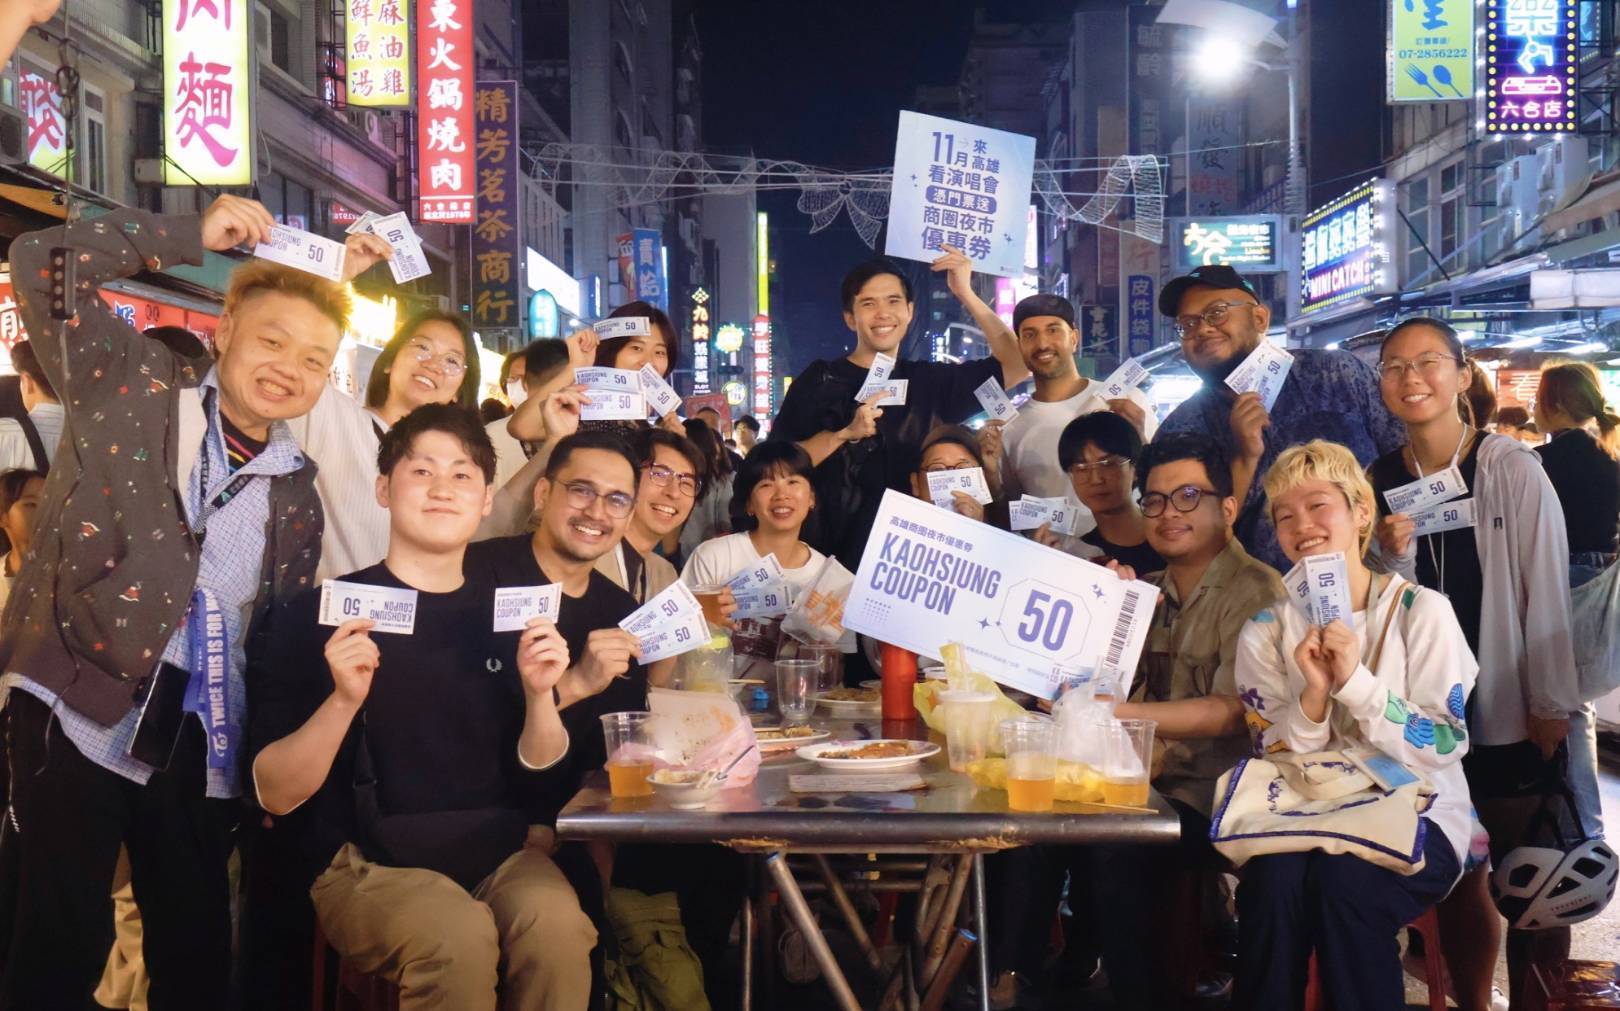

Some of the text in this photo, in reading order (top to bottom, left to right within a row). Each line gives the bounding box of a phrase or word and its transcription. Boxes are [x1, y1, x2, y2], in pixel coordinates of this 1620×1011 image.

[1399, 49, 1467, 58] 07-2856222
[176, 0, 238, 167] 麵
[1501, 100, 1562, 118] 六合店
[928, 164, 1000, 194] 看演唱會
[475, 88, 514, 323] 精芳茗茶商行
[923, 205, 995, 235] 商圈夜市
[387, 229, 404, 244] 50
[307, 244, 324, 263] 50
[625, 321, 636, 330] 50
[875, 366, 885, 378] 50
[1267, 360, 1281, 375] 50
[614, 375, 627, 385] 50
[1108, 384, 1122, 396] 50
[619, 396, 631, 409] 50
[657, 391, 670, 405] 50
[994, 403, 1006, 416] 50
[960, 476, 972, 488] 50
[1429, 480, 1446, 495] 50
[1051, 510, 1064, 523] 50
[1443, 509, 1458, 522] 50
[888, 515, 974, 553] 高雄商圈夜市優惠券
[879, 531, 1002, 600] KAOHSIUNG
[755, 567, 769, 583] 50
[1318, 572, 1336, 588] 50
[869, 560, 957, 616] COUPON
[1296, 580, 1310, 598] 50
[342, 596, 361, 616] 50
[383, 601, 414, 613] COUPON
[496, 597, 532, 608] KAOHSIUNG
[538, 596, 549, 614] 50
[764, 594, 777, 607] 50
[368, 609, 413, 623] KAOHSIUNG
[496, 608, 521, 619] COUPON
[660, 599, 680, 618] 50
[206, 612, 223, 638] FOR
[1016, 588, 1074, 653] 50
[674, 627, 690, 643] 50
[206, 639, 224, 653] IS
[207, 655, 224, 685] THIS
[208, 686, 226, 728] TWICE
